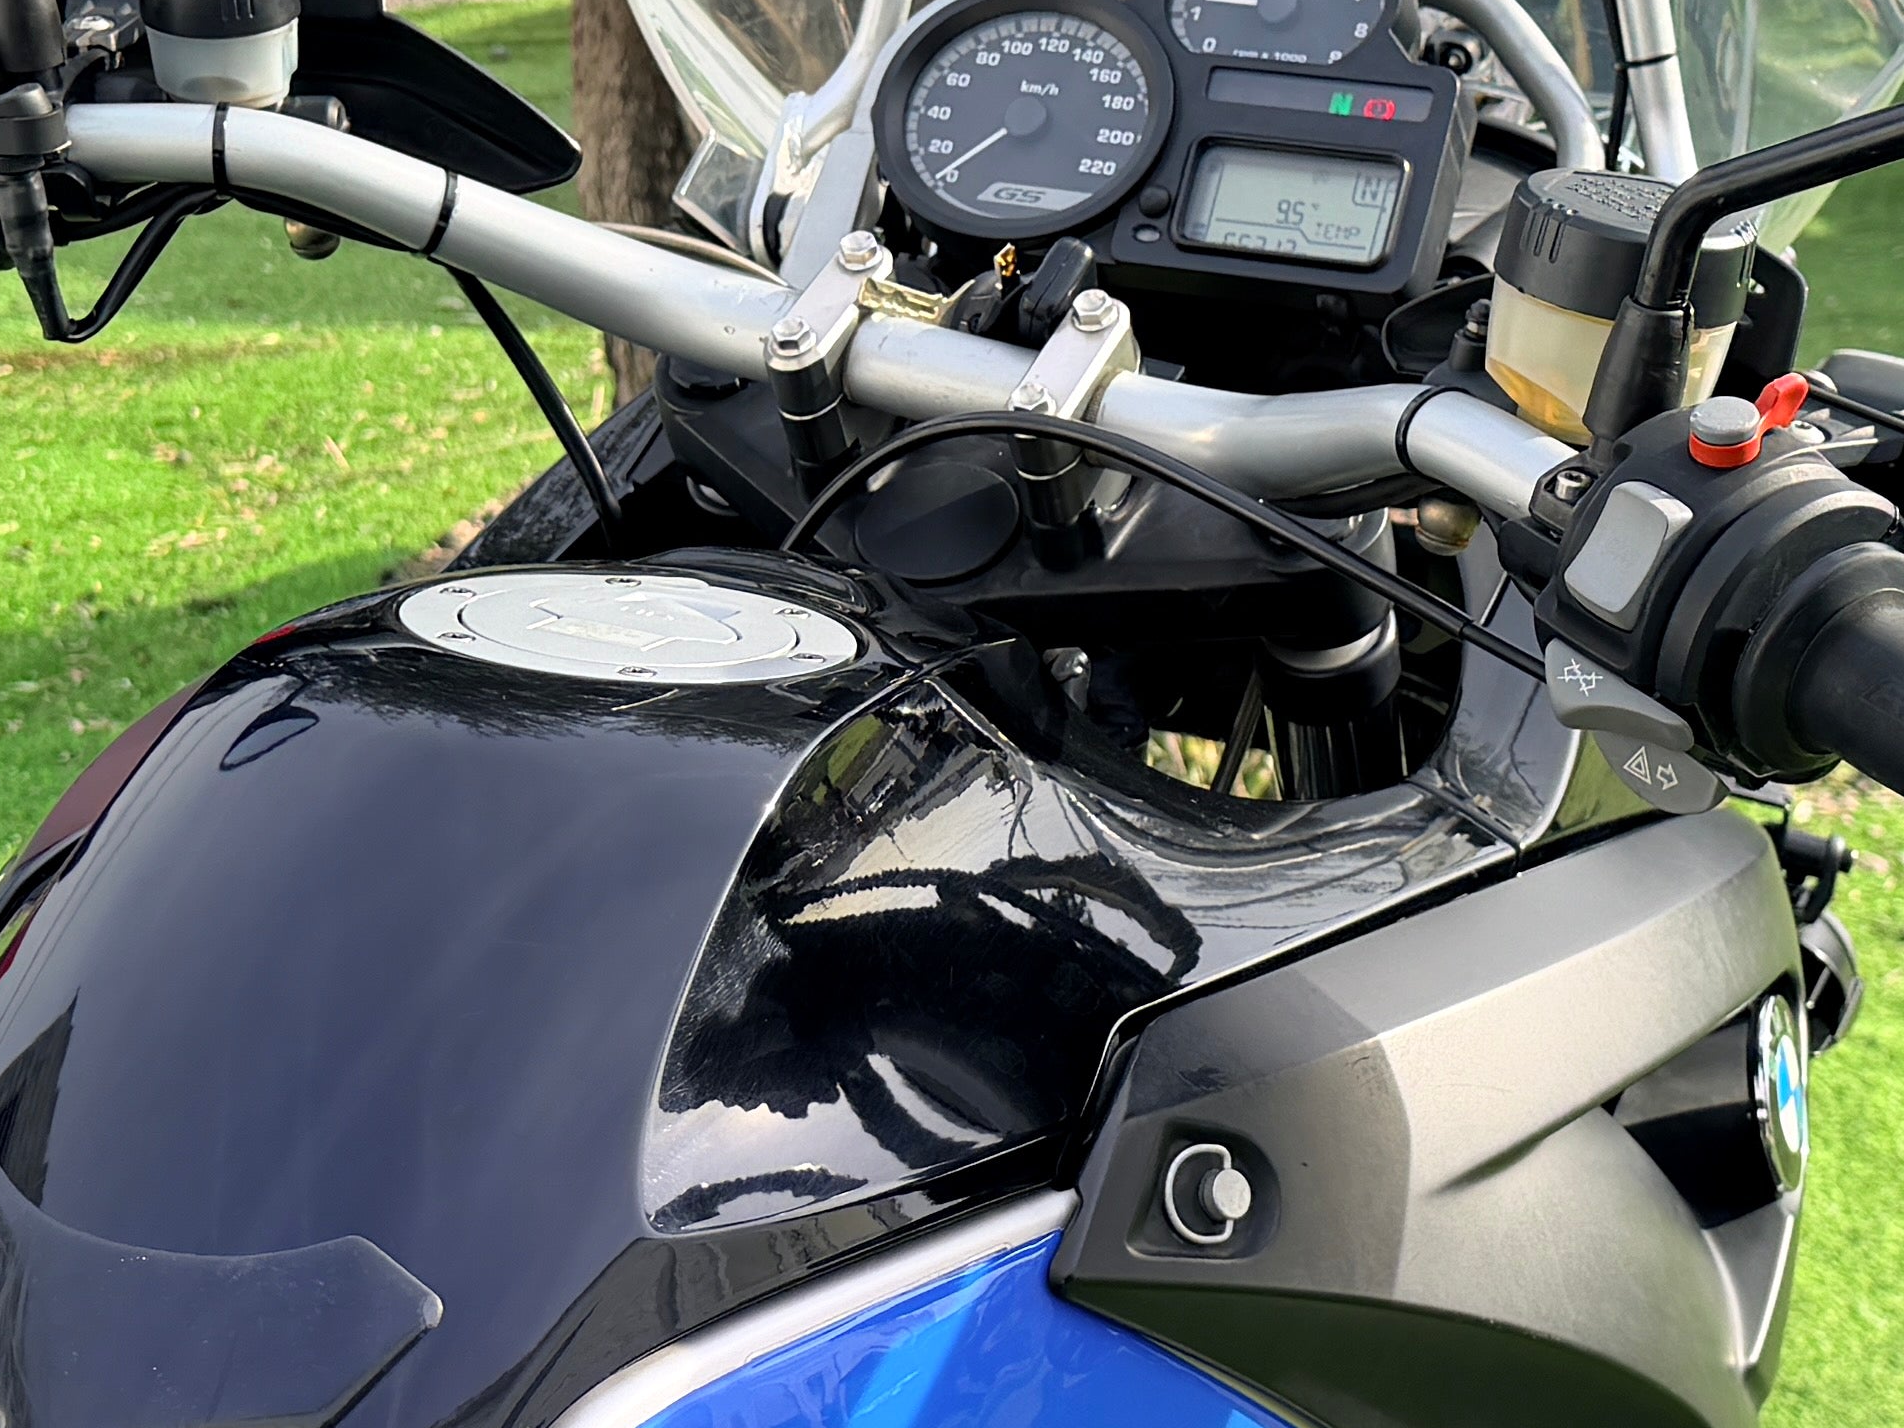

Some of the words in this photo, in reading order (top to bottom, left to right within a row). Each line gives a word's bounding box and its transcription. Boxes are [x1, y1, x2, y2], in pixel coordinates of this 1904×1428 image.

[1190, 6, 1202, 21] 1
[1354, 22, 1369, 38] 8
[1001, 40, 1033, 56] 100
[1038, 37, 1070, 53] 120
[1202, 37, 1217, 52] 0
[976, 51, 1001, 66] 80
[1072, 48, 1104, 64] 140
[1274, 51, 1307, 63] 1000
[946, 73, 971, 87] 60
[1089, 67, 1122, 84] 160
[1020, 80, 1059, 96] km/h
[1102, 94, 1134, 111] 180
[1328, 92, 1354, 116] N
[928, 106, 951, 120] 40
[1097, 128, 1134, 146] 200
[928, 139, 953, 154] 20
[1078, 158, 1116, 176] 220
[946, 169, 959, 183] 0
[993, 186, 1047, 204] GS
[1316, 222, 1362, 241] TEMP
